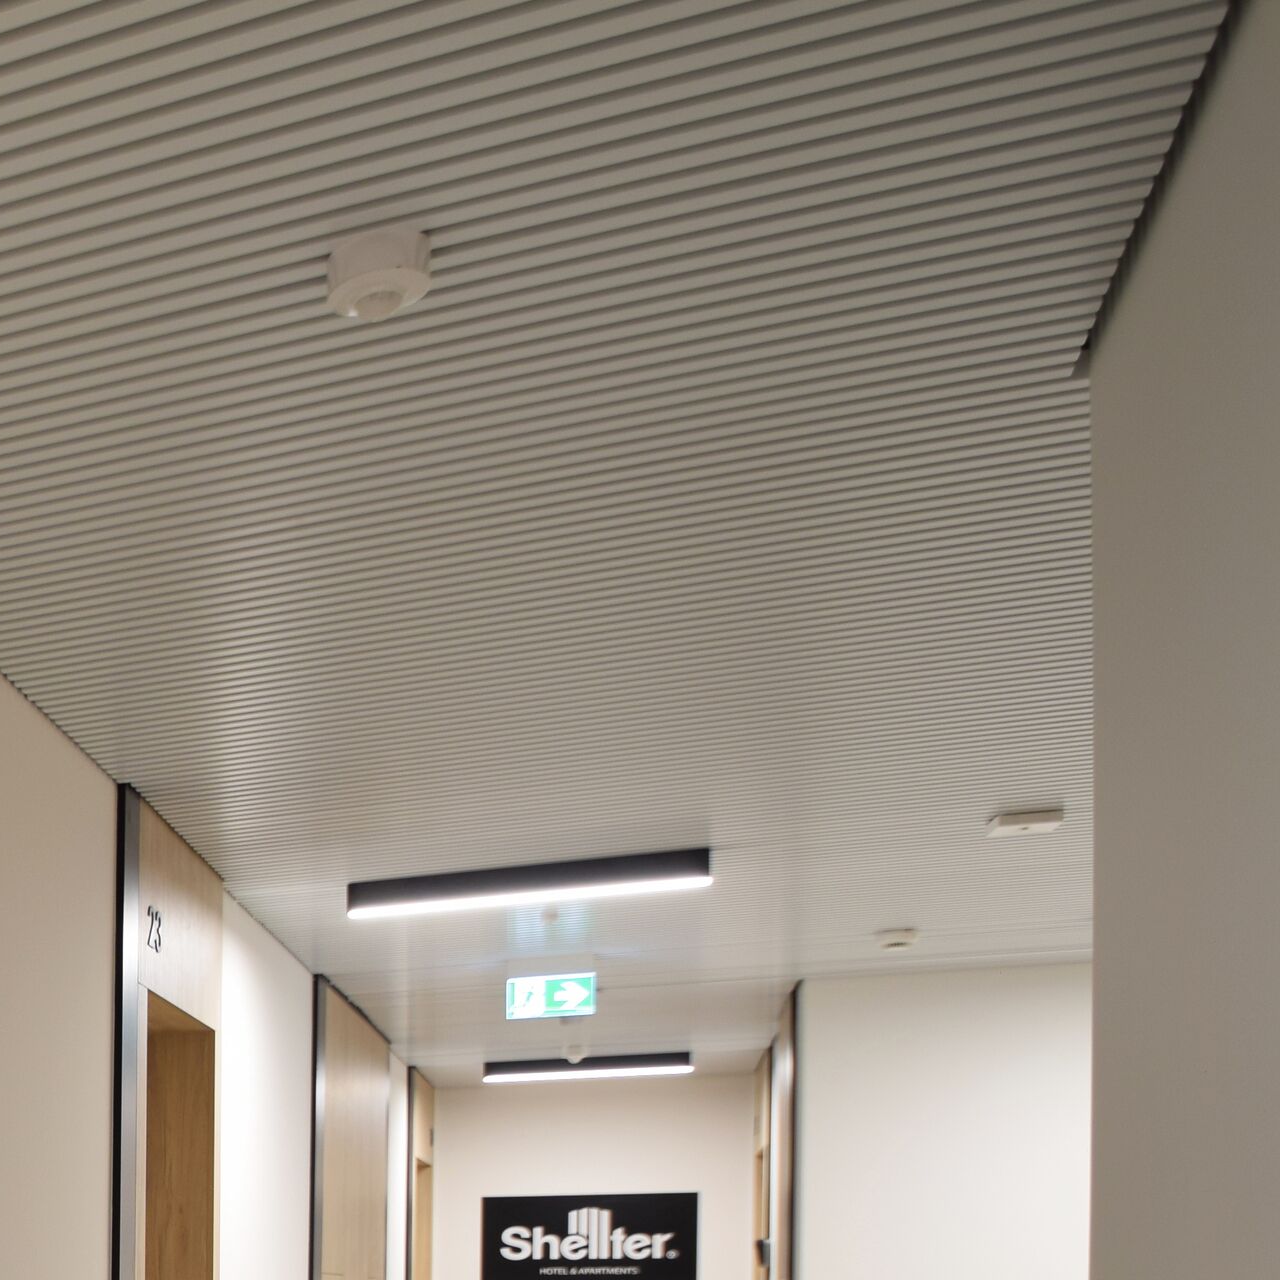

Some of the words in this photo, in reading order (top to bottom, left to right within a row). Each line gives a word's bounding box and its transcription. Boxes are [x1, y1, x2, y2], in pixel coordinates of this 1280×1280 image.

[147, 905, 162, 953] 23
[539, 1267, 568, 1276] HOTEL
[569, 1267, 577, 1276] &
[578, 1266, 640, 1276] APARTMENTS
